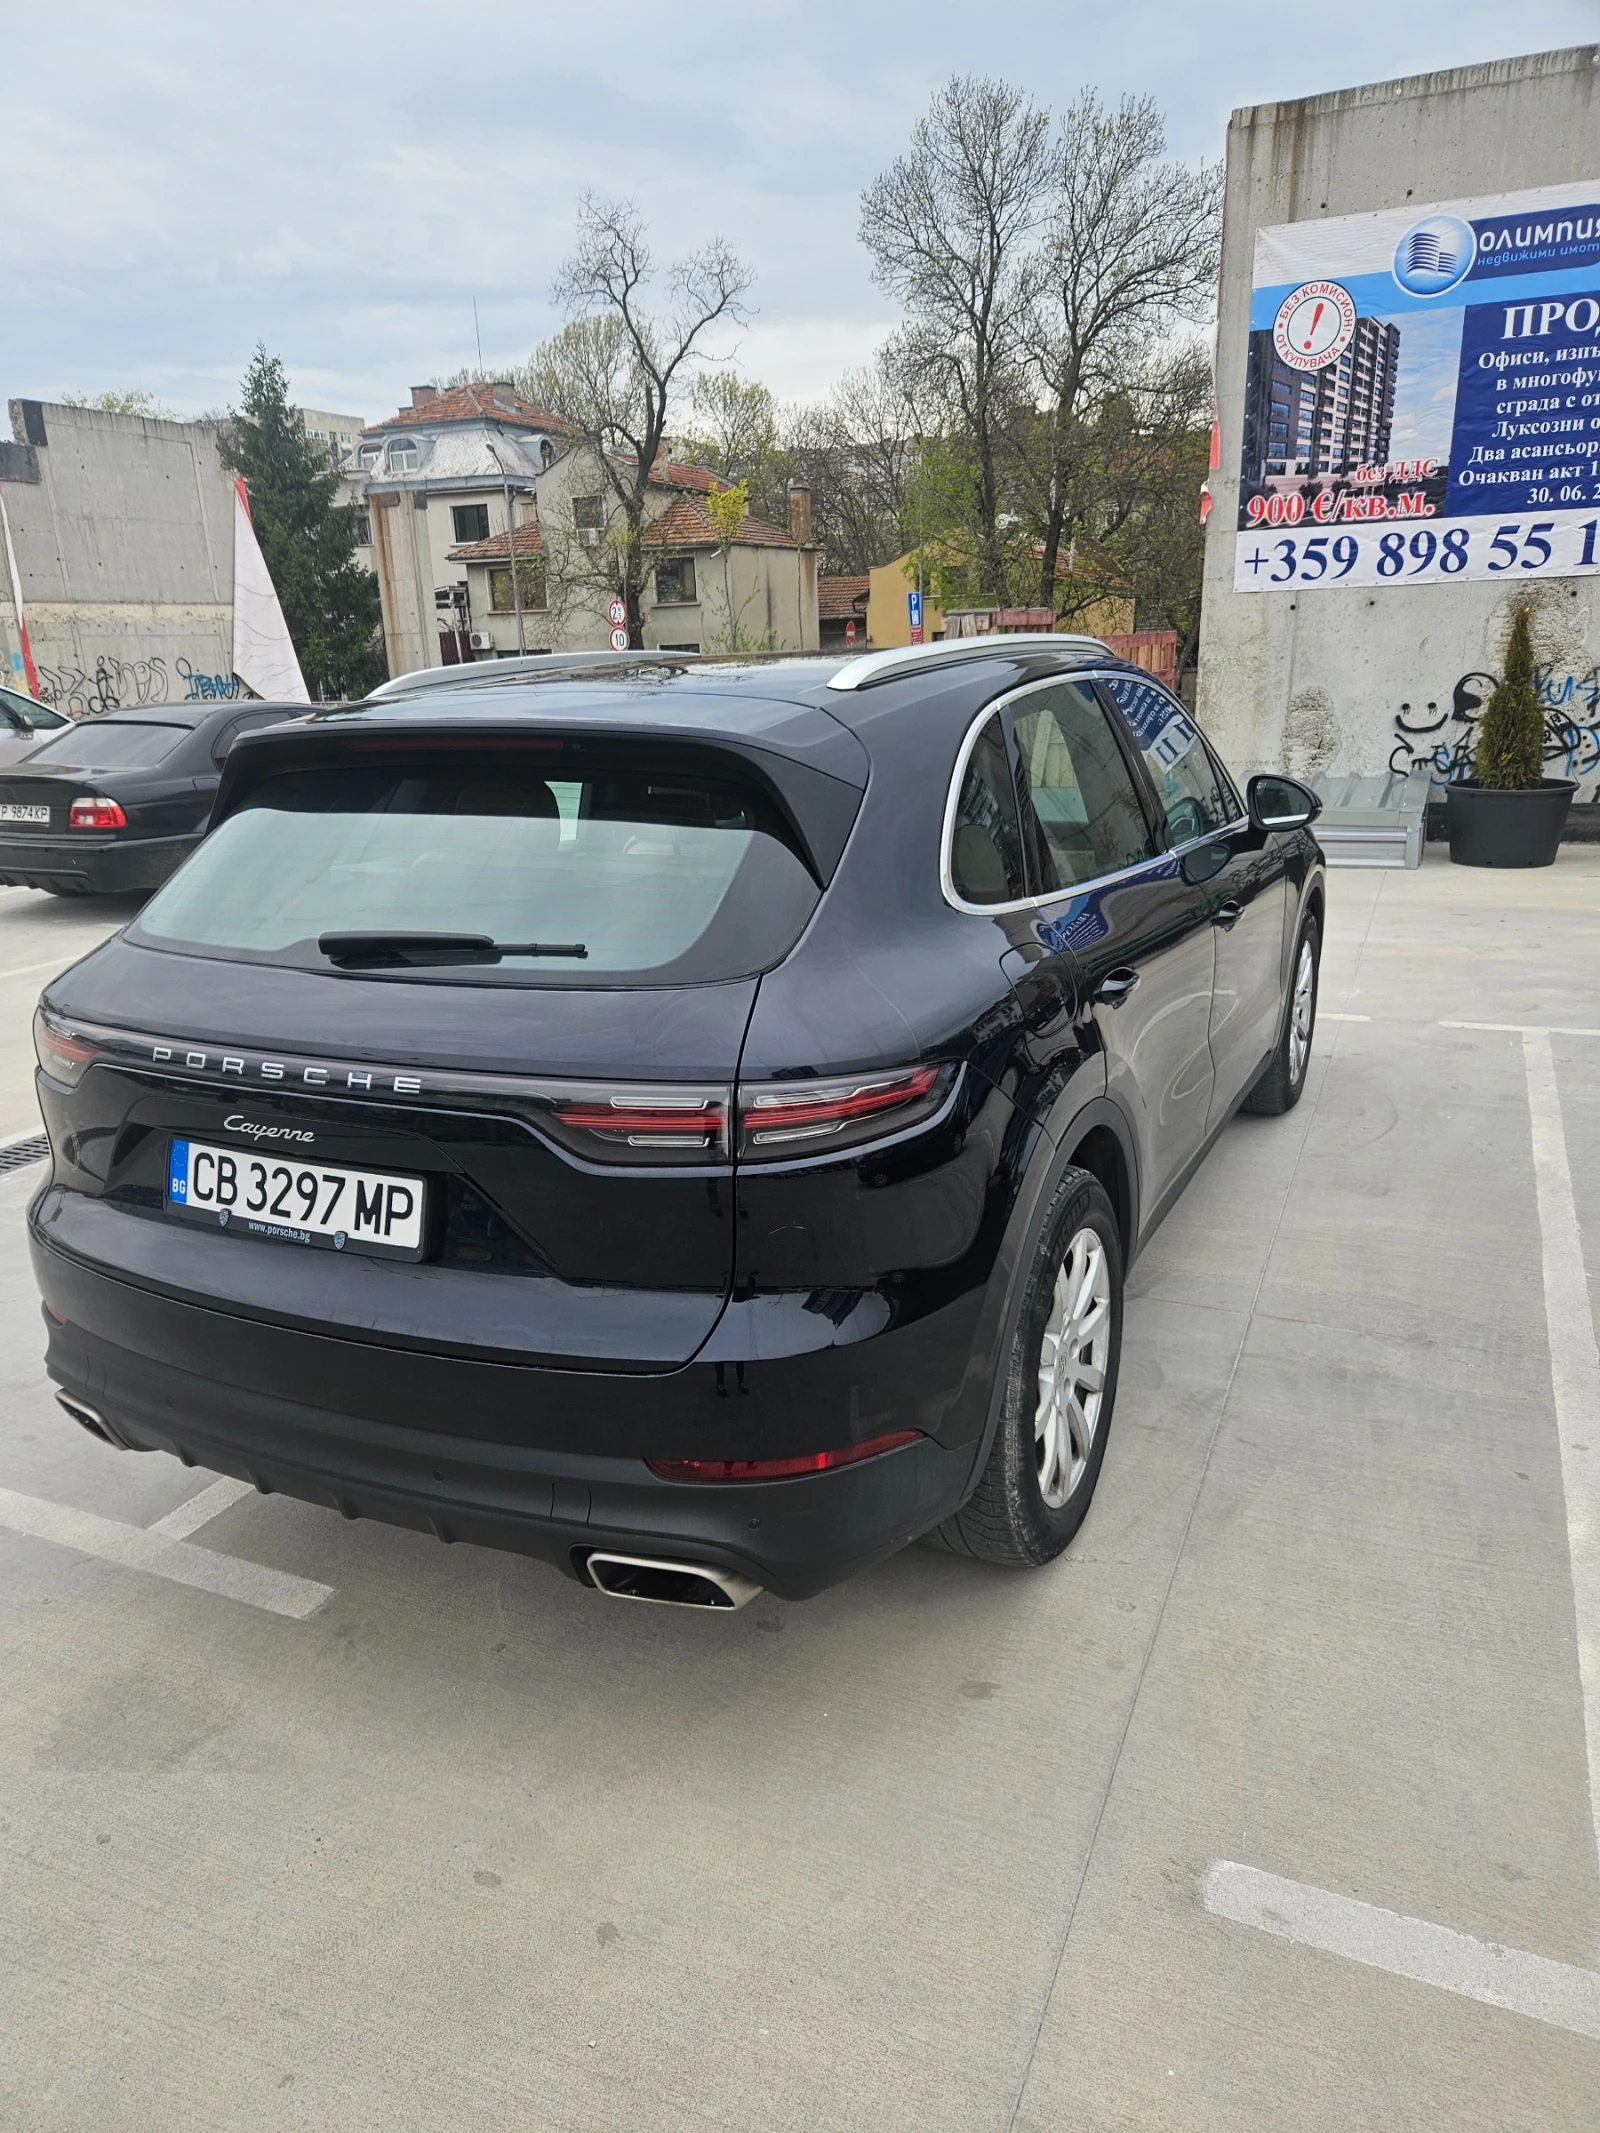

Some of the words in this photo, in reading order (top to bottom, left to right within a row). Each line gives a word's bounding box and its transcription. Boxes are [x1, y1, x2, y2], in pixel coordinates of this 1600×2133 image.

[1477, 248, 1556, 266] недвижими
[1280, 294, 1300, 320] БЕЗ
[1302, 284, 1354, 332] КОМИСИОН!
[1500, 298, 1600, 339] ПРО
[1276, 334, 1287, 350] ОТ
[1283, 347, 1341, 369] КУПУВАЧА
[1478, 351, 1550, 371] Офиси,
[1496, 379, 1508, 391] в
[1512, 367, 1600, 390] многофу
[1496, 396, 1560, 417] сграда
[1566, 395, 1576, 408] с
[1491, 418, 1585, 441] Луксозни
[1467, 446, 1505, 466] Два
[1510, 440, 1600, 460] асансьор
[1356, 463, 1386, 482] без
[1389, 458, 1439, 483] ДДС
[1458, 468, 1544, 487] Очакван
[1549, 465, 1585, 480] акт
[1527, 486, 1554, 504] 30.
[1560, 484, 1587, 502] 06.
[1247, 493, 1305, 527] 900
[1244, 535, 1359, 582] +359
[1376, 528, 1470, 577] 898
[1487, 522, 1555, 571] 55
[1574, 519, 1598, 565] 1
[615, 633, 625, 647] 10
[152, 1046, 422, 1094] PORSCHE
[223, 1114, 316, 1142] Cayenne
[171, 1178, 187, 1195] BG
[192, 1152, 239, 1206] CB
[246, 1162, 346, 1226] 3297
[354, 1179, 415, 1236] MP
[248, 1221, 311, 1243] www.porsche.bg
